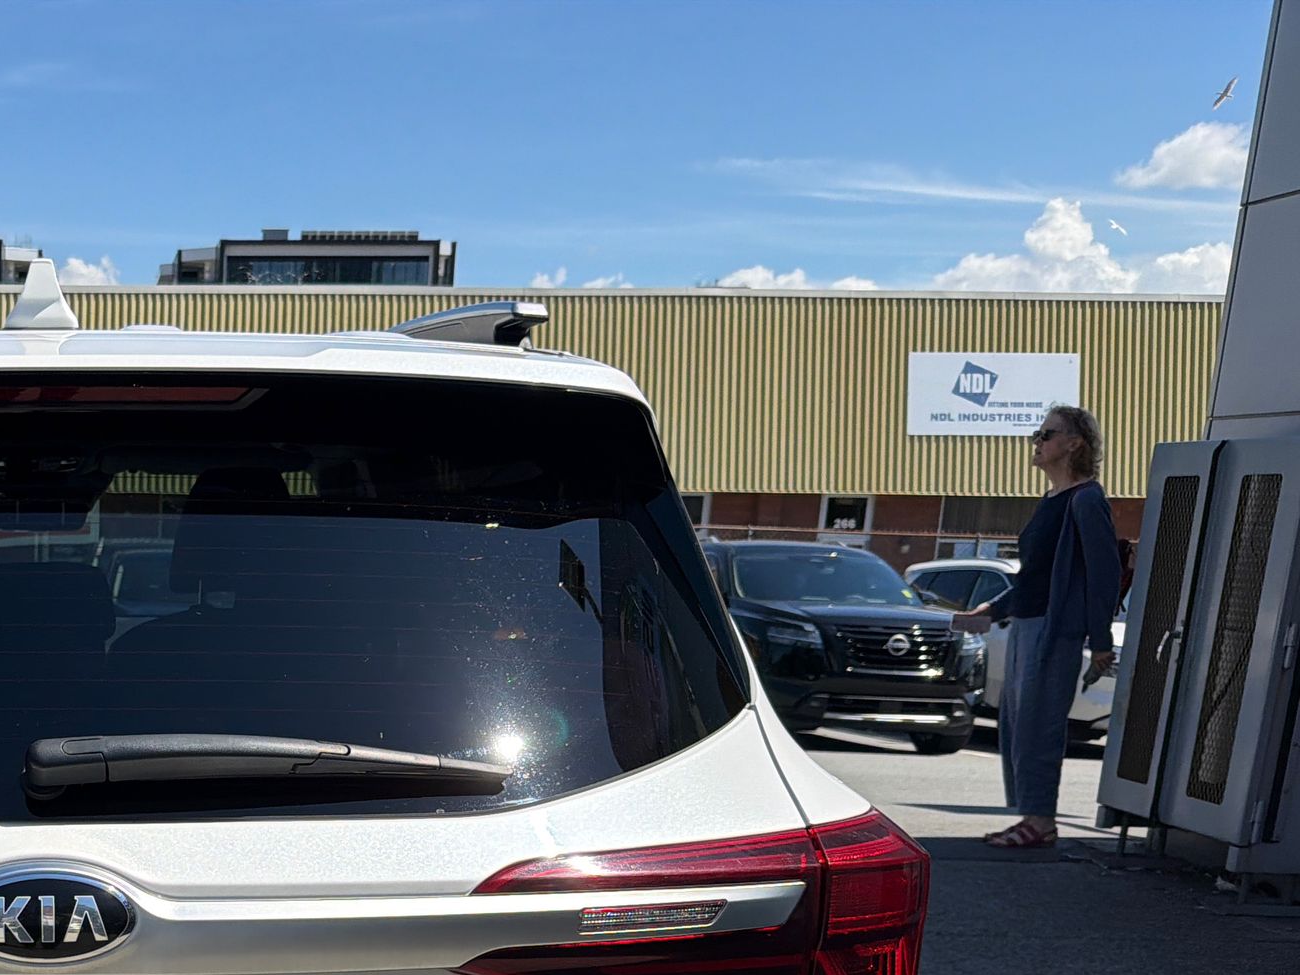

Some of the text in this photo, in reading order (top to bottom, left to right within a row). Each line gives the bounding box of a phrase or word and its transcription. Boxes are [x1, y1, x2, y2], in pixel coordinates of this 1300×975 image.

[959, 373, 993, 394] NDL
[930, 412, 955, 422] NDL
[958, 412, 1032, 422] INDUSTRIES
